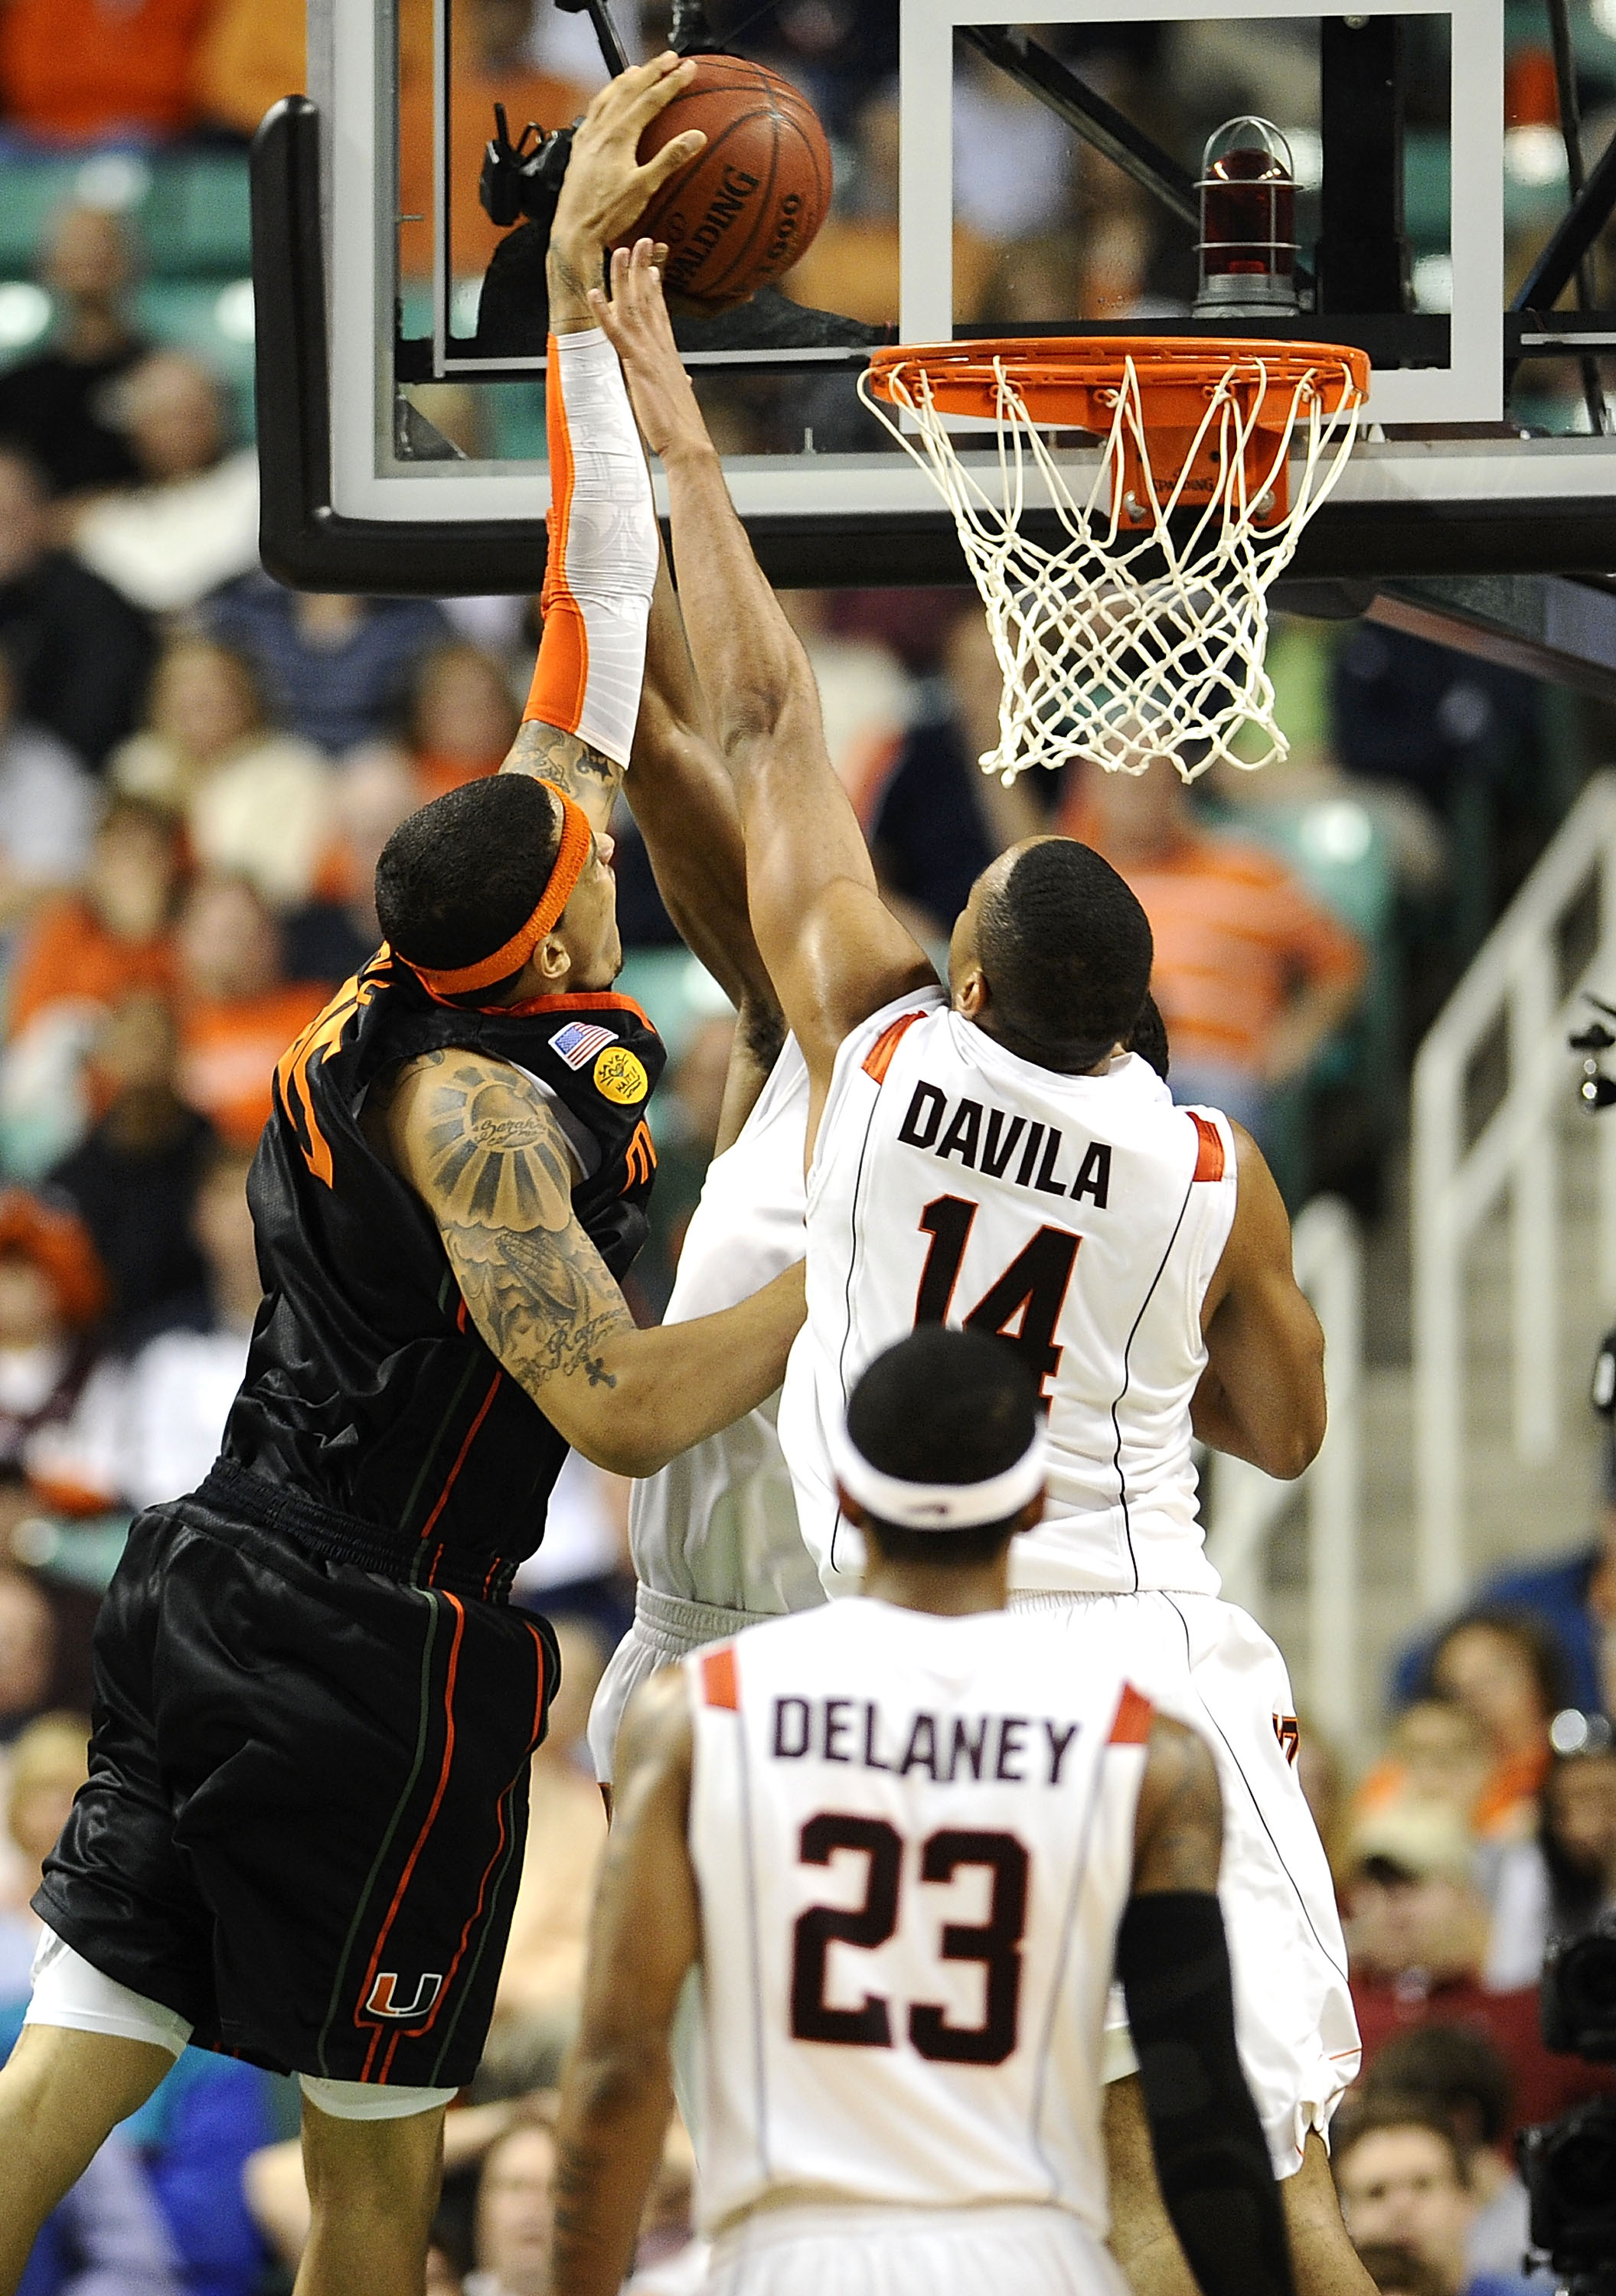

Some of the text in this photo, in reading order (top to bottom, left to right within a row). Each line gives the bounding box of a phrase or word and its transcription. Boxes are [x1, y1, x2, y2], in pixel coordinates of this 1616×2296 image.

[897, 1079, 1113, 1210] DAVILA
[914, 1193, 1083, 1425] 14
[771, 1695, 1081, 1785] DELANEY
[366, 1972, 442, 2017] U
[791, 1811, 1030, 2065] 23
